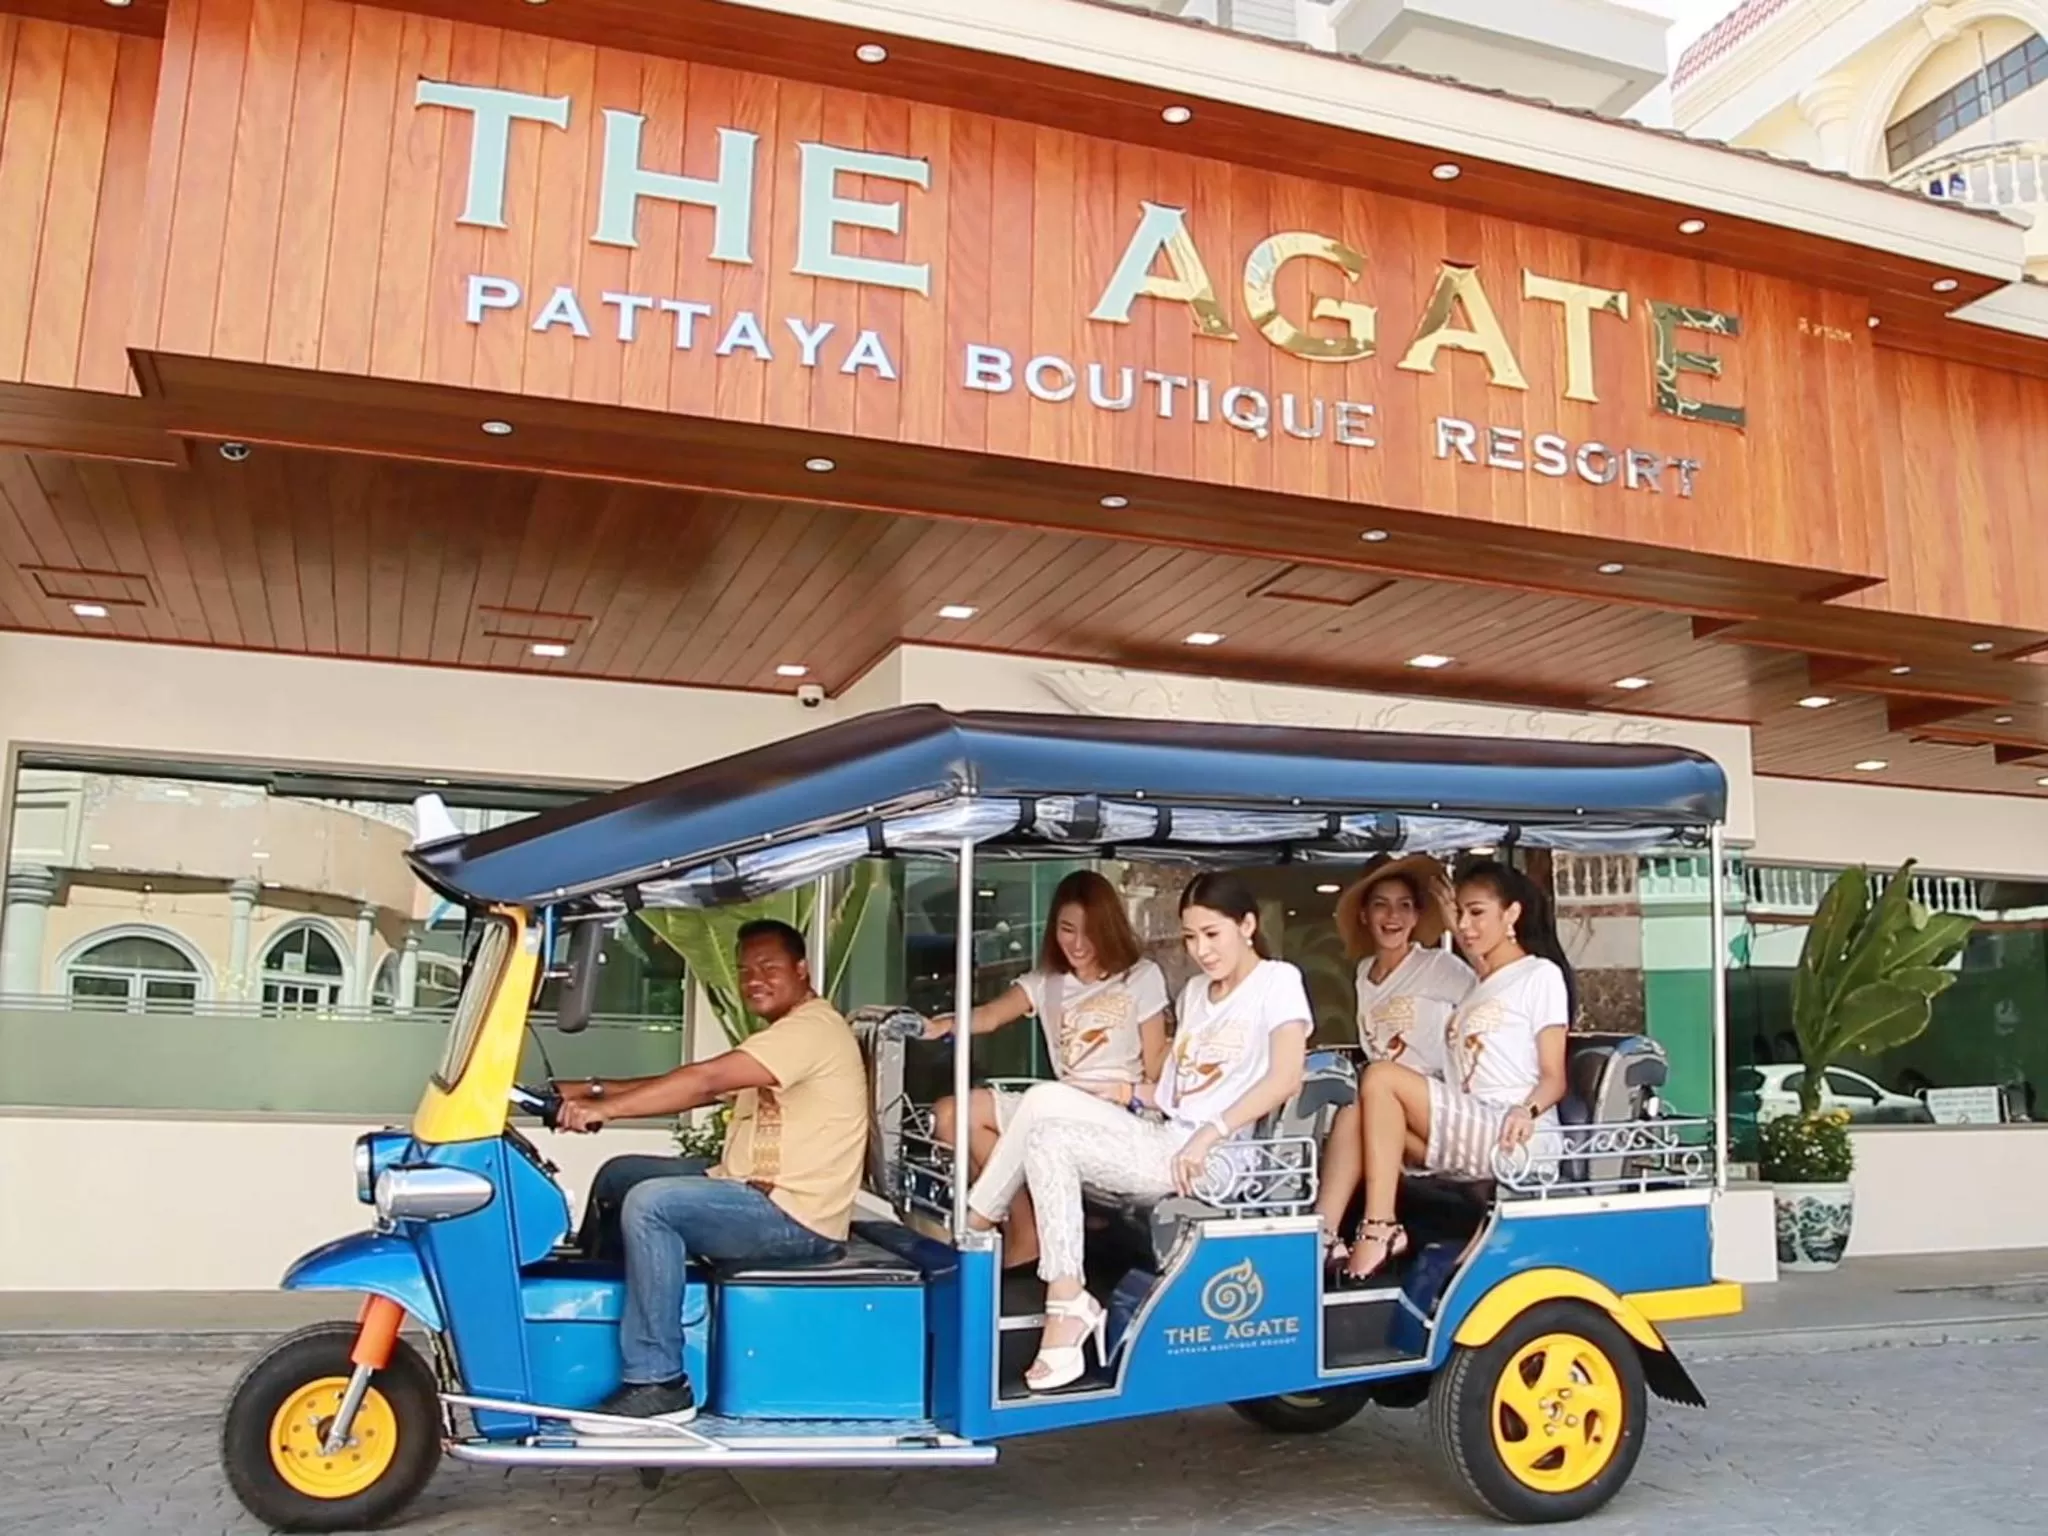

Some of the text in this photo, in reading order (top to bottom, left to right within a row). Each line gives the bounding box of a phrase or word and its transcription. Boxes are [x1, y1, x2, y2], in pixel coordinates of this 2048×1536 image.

[415, 79, 1747, 432] THE AGATE
[465, 274, 1700, 499] PATTAYA BOUTIQUE RESORT
[1163, 1316, 1300, 1345] THE AGATE
